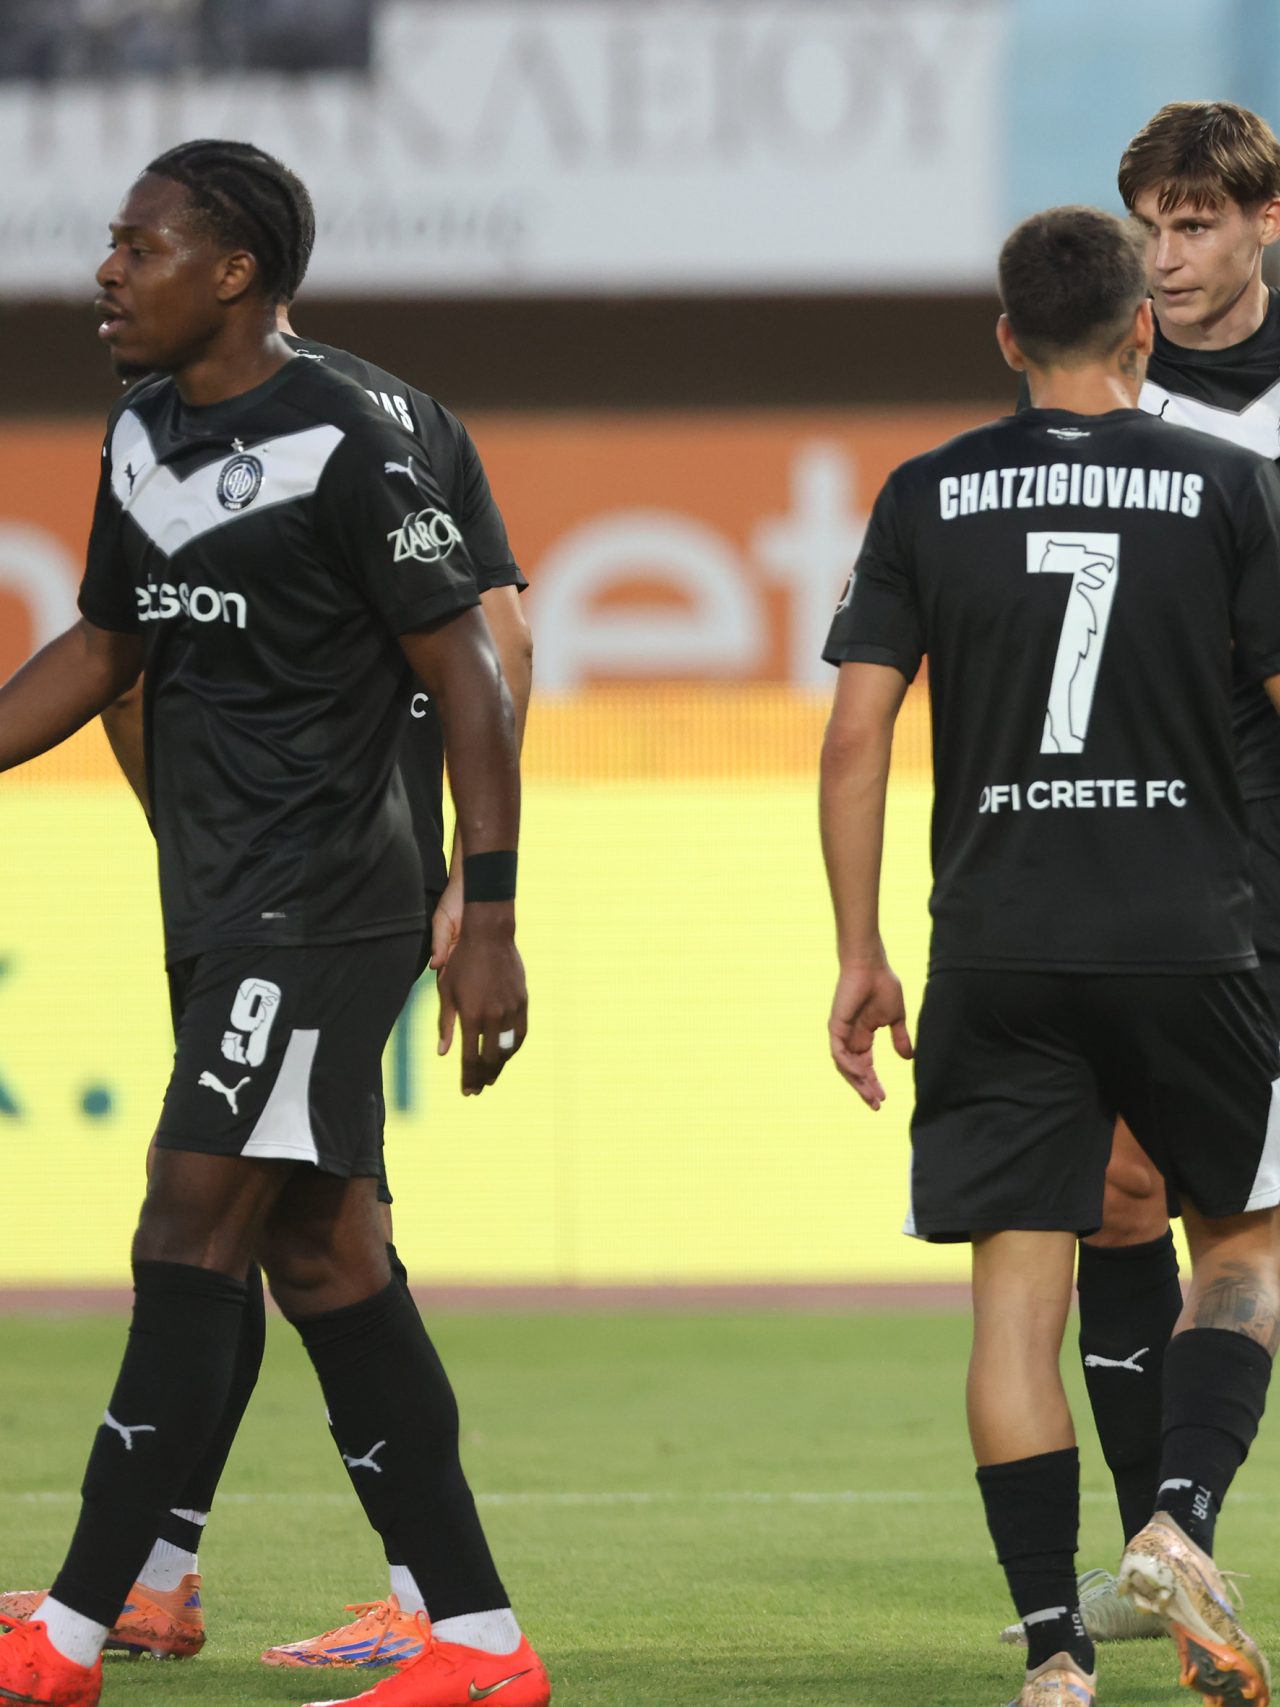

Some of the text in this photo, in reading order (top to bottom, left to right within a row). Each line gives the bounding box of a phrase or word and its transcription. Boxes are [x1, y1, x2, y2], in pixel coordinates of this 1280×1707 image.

[939, 463, 1204, 520] CHATZIGIOVANIS
[1026, 531, 1120, 754] 7
[1026, 780, 1138, 810] CRETE
[1146, 779, 1188, 808] FC
[220, 977, 282, 1068] 9
